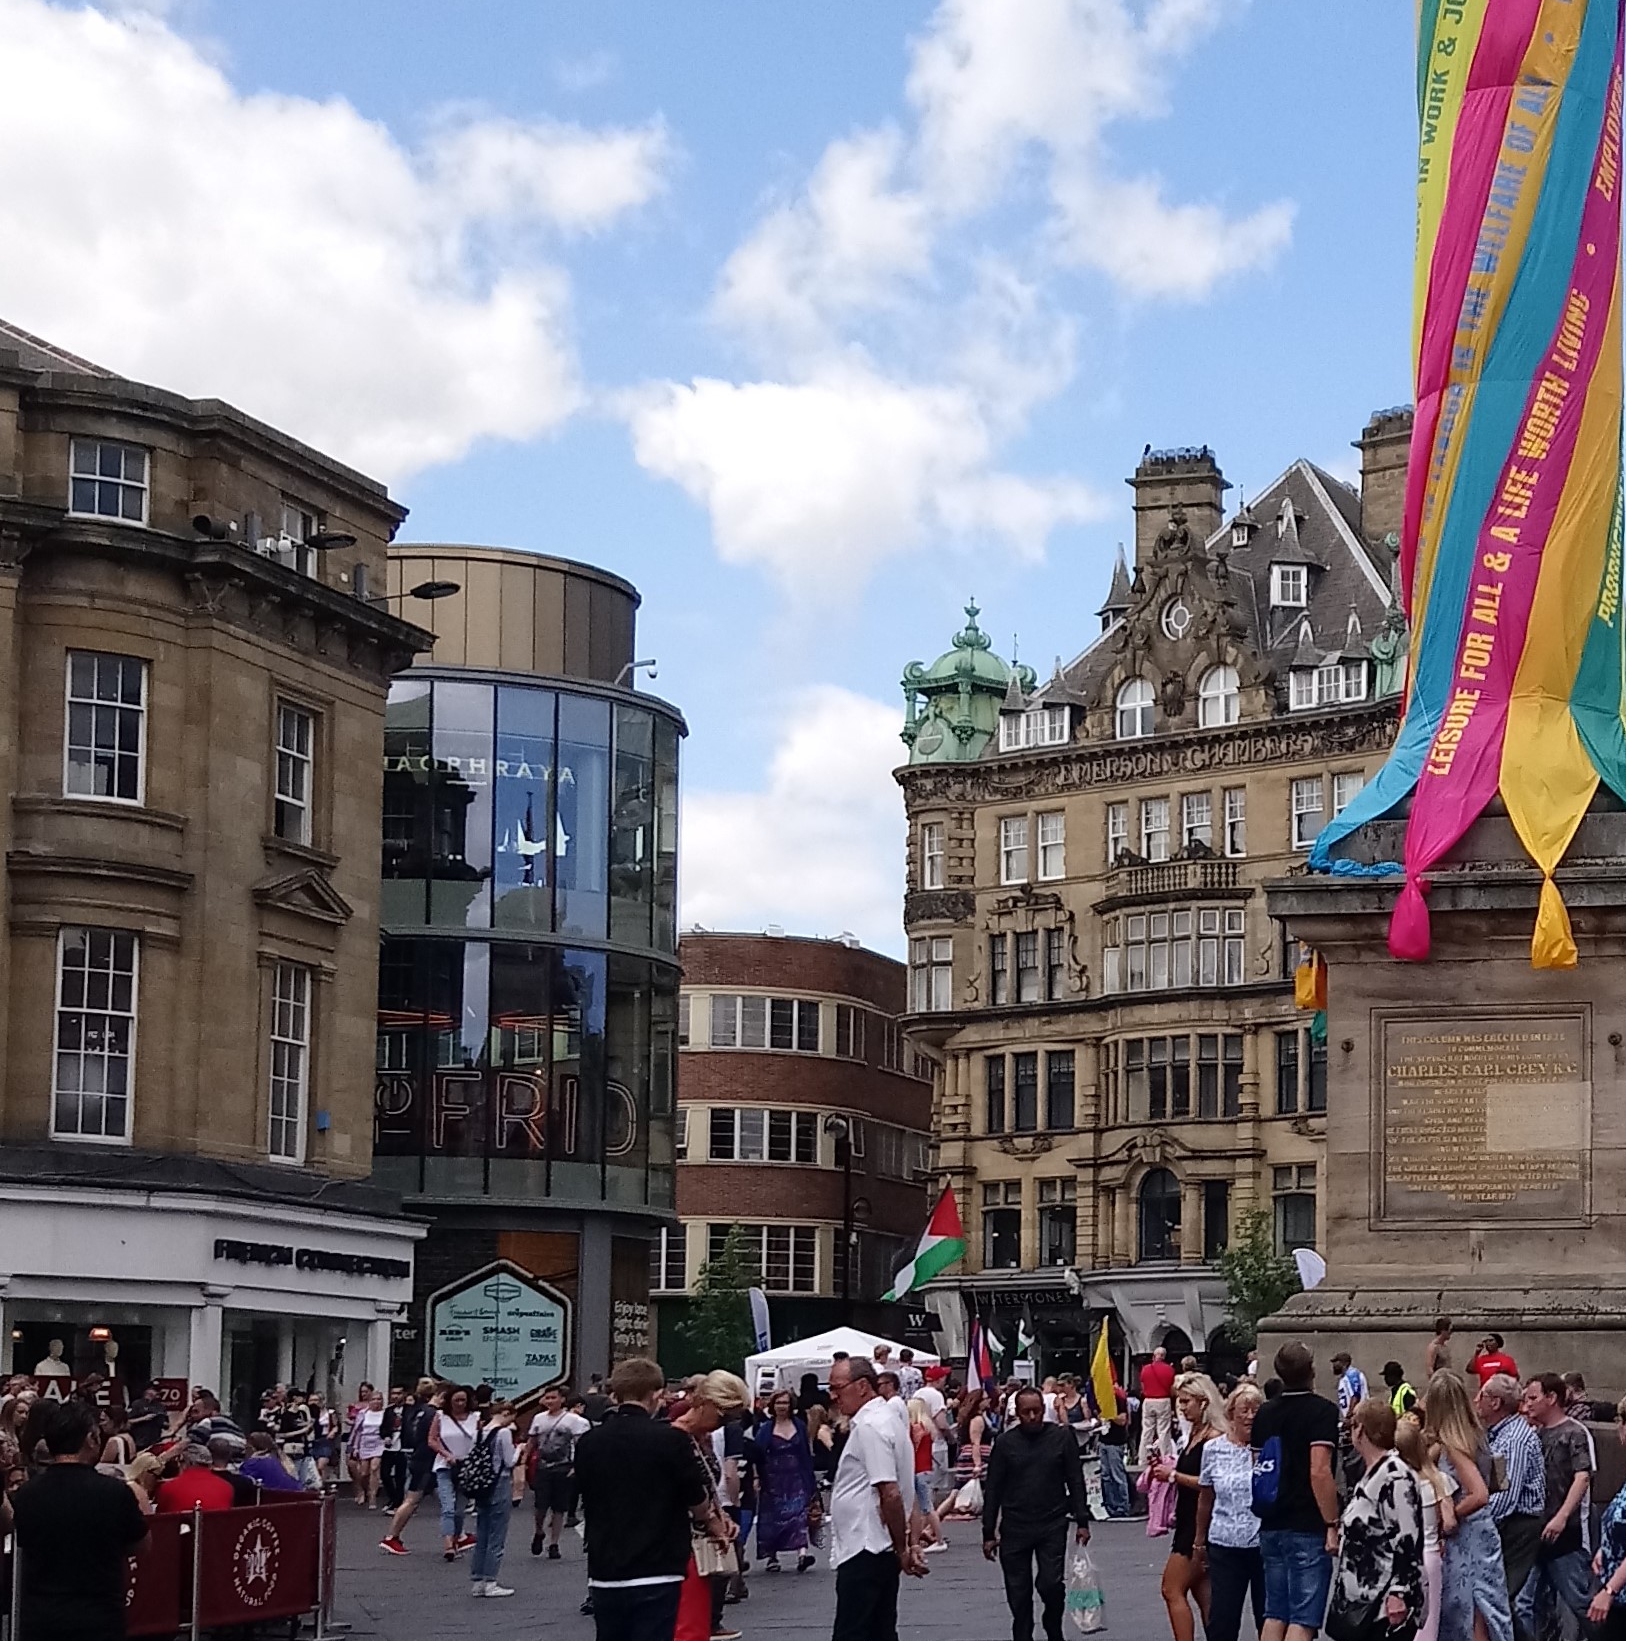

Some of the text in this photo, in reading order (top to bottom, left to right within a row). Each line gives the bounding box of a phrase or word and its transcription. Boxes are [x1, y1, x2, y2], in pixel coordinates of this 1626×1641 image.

[1422, 68, 1451, 146] WORK
[1437, 35, 1458, 58] &
[1505, 120, 1537, 154] OF
[1427, 288, 1590, 776] LEISURE FOR ALL & A LIFE WORTH LIVING
[384, 755, 577, 785] AOPHRAYA
[1056, 731, 1313, 786] EMERSON CHAMBERS
[1387, 1065, 1458, 1077] CHARLES
[1462, 1063, 1505, 1076] EARL
[1506, 1062, 1549, 1075] GREY
[482, 1326, 520, 1335] SMASH
[907, 1314, 926, 1327] W
[233, 1517, 262, 1560] ORGANIC
[233, 1576, 264, 1607] NATURAL
